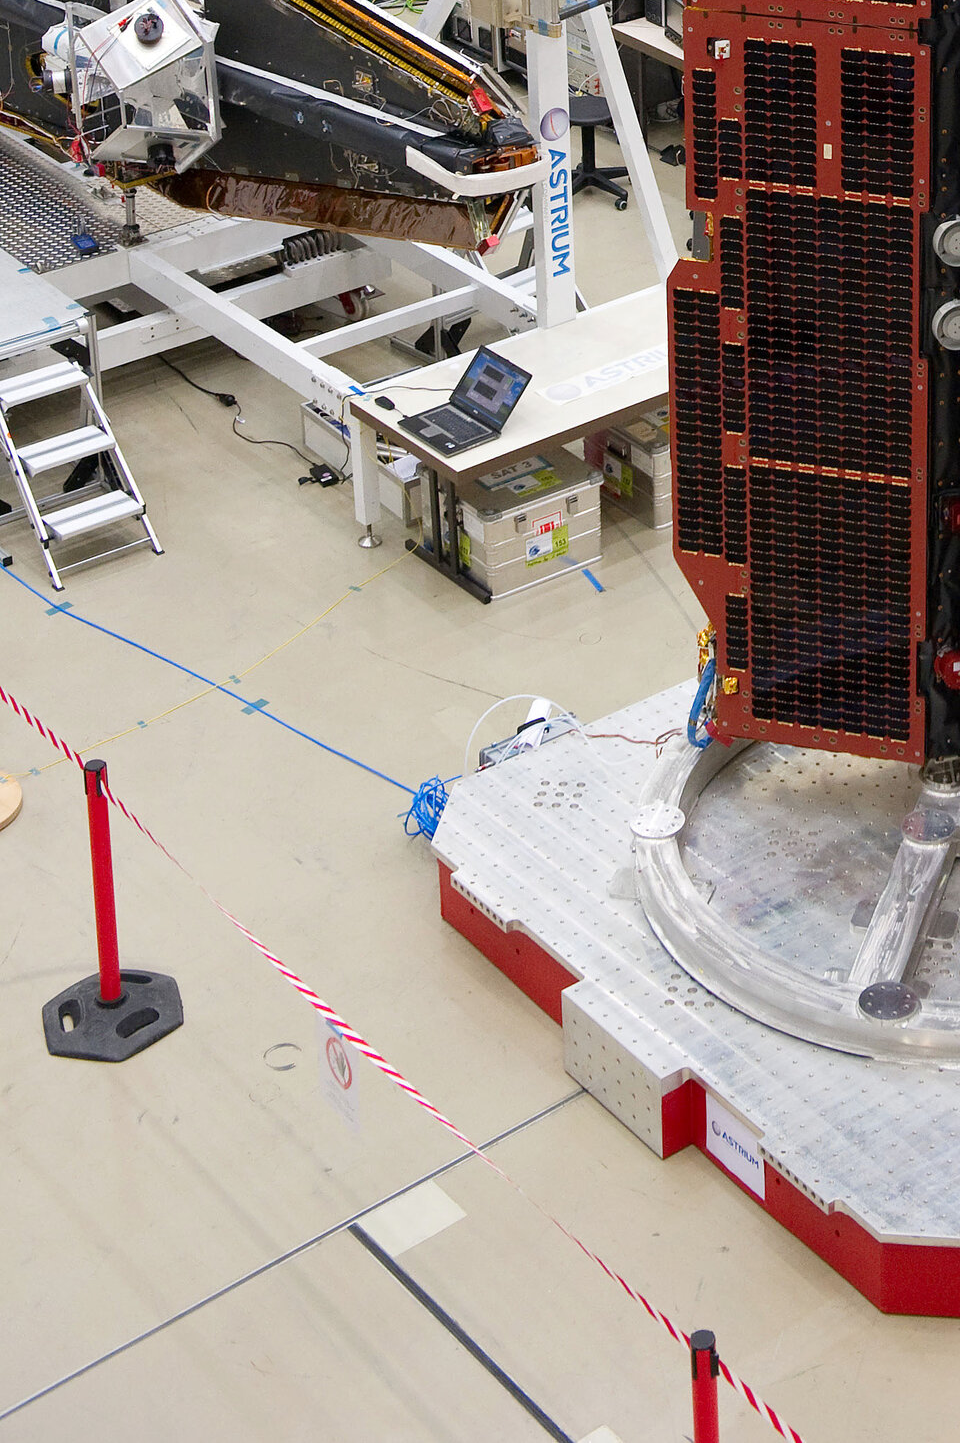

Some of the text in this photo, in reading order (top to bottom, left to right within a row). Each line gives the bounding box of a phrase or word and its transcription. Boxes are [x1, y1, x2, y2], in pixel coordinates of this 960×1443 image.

[548, 149, 570, 277] ASTRIUM
[491, 465, 517, 479] SAT
[722, 1131, 759, 1169] ASTRIUM
